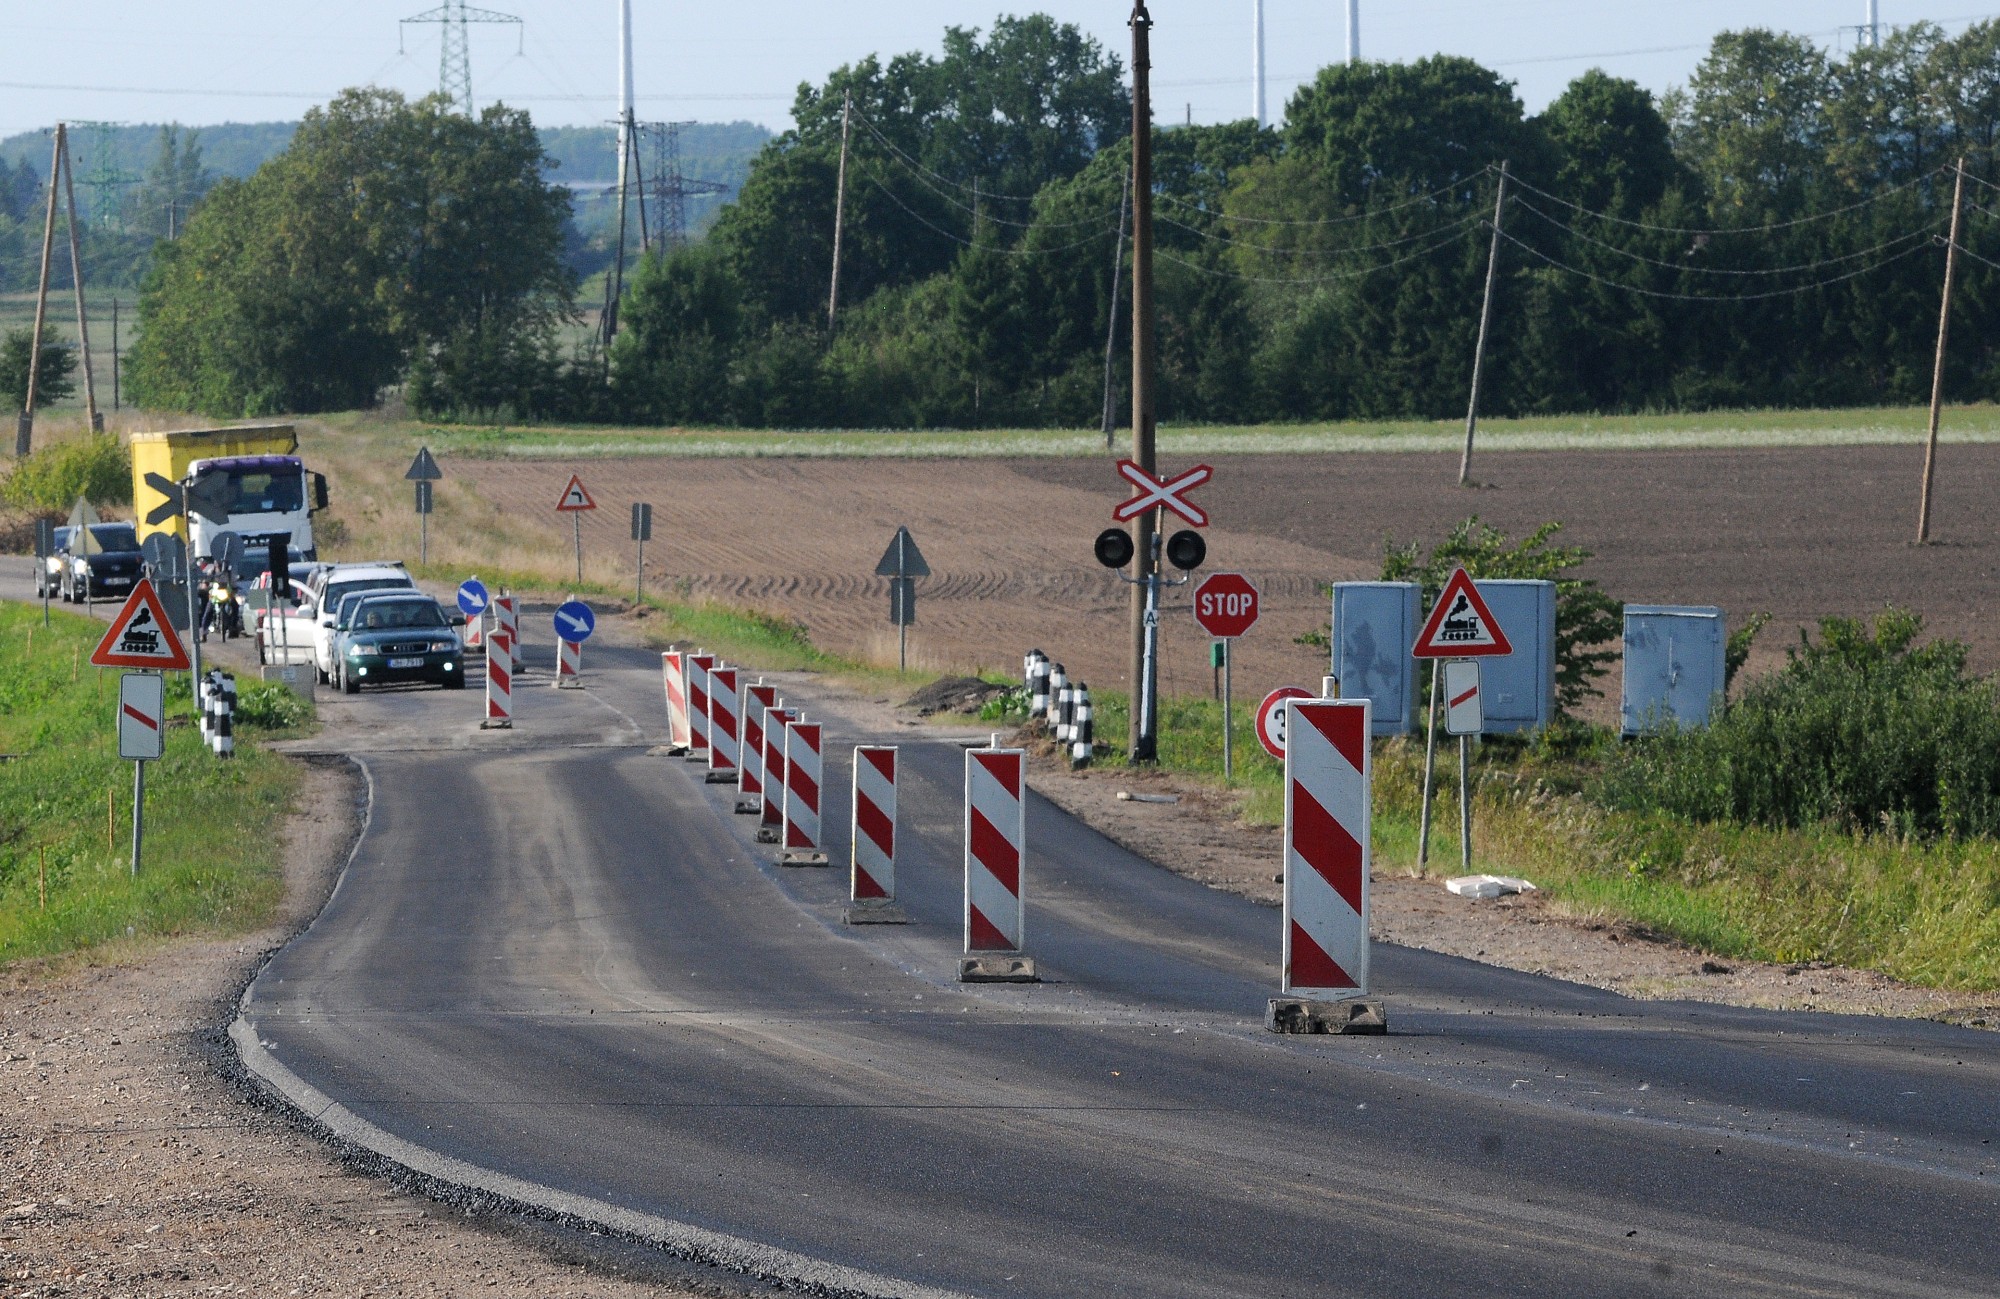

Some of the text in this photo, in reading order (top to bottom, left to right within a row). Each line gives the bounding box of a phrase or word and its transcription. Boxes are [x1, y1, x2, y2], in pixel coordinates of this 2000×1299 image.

[1201, 593, 1253, 616] STOP
[1145, 611, 1156, 625] A
[1274, 708, 1285, 743] 3
